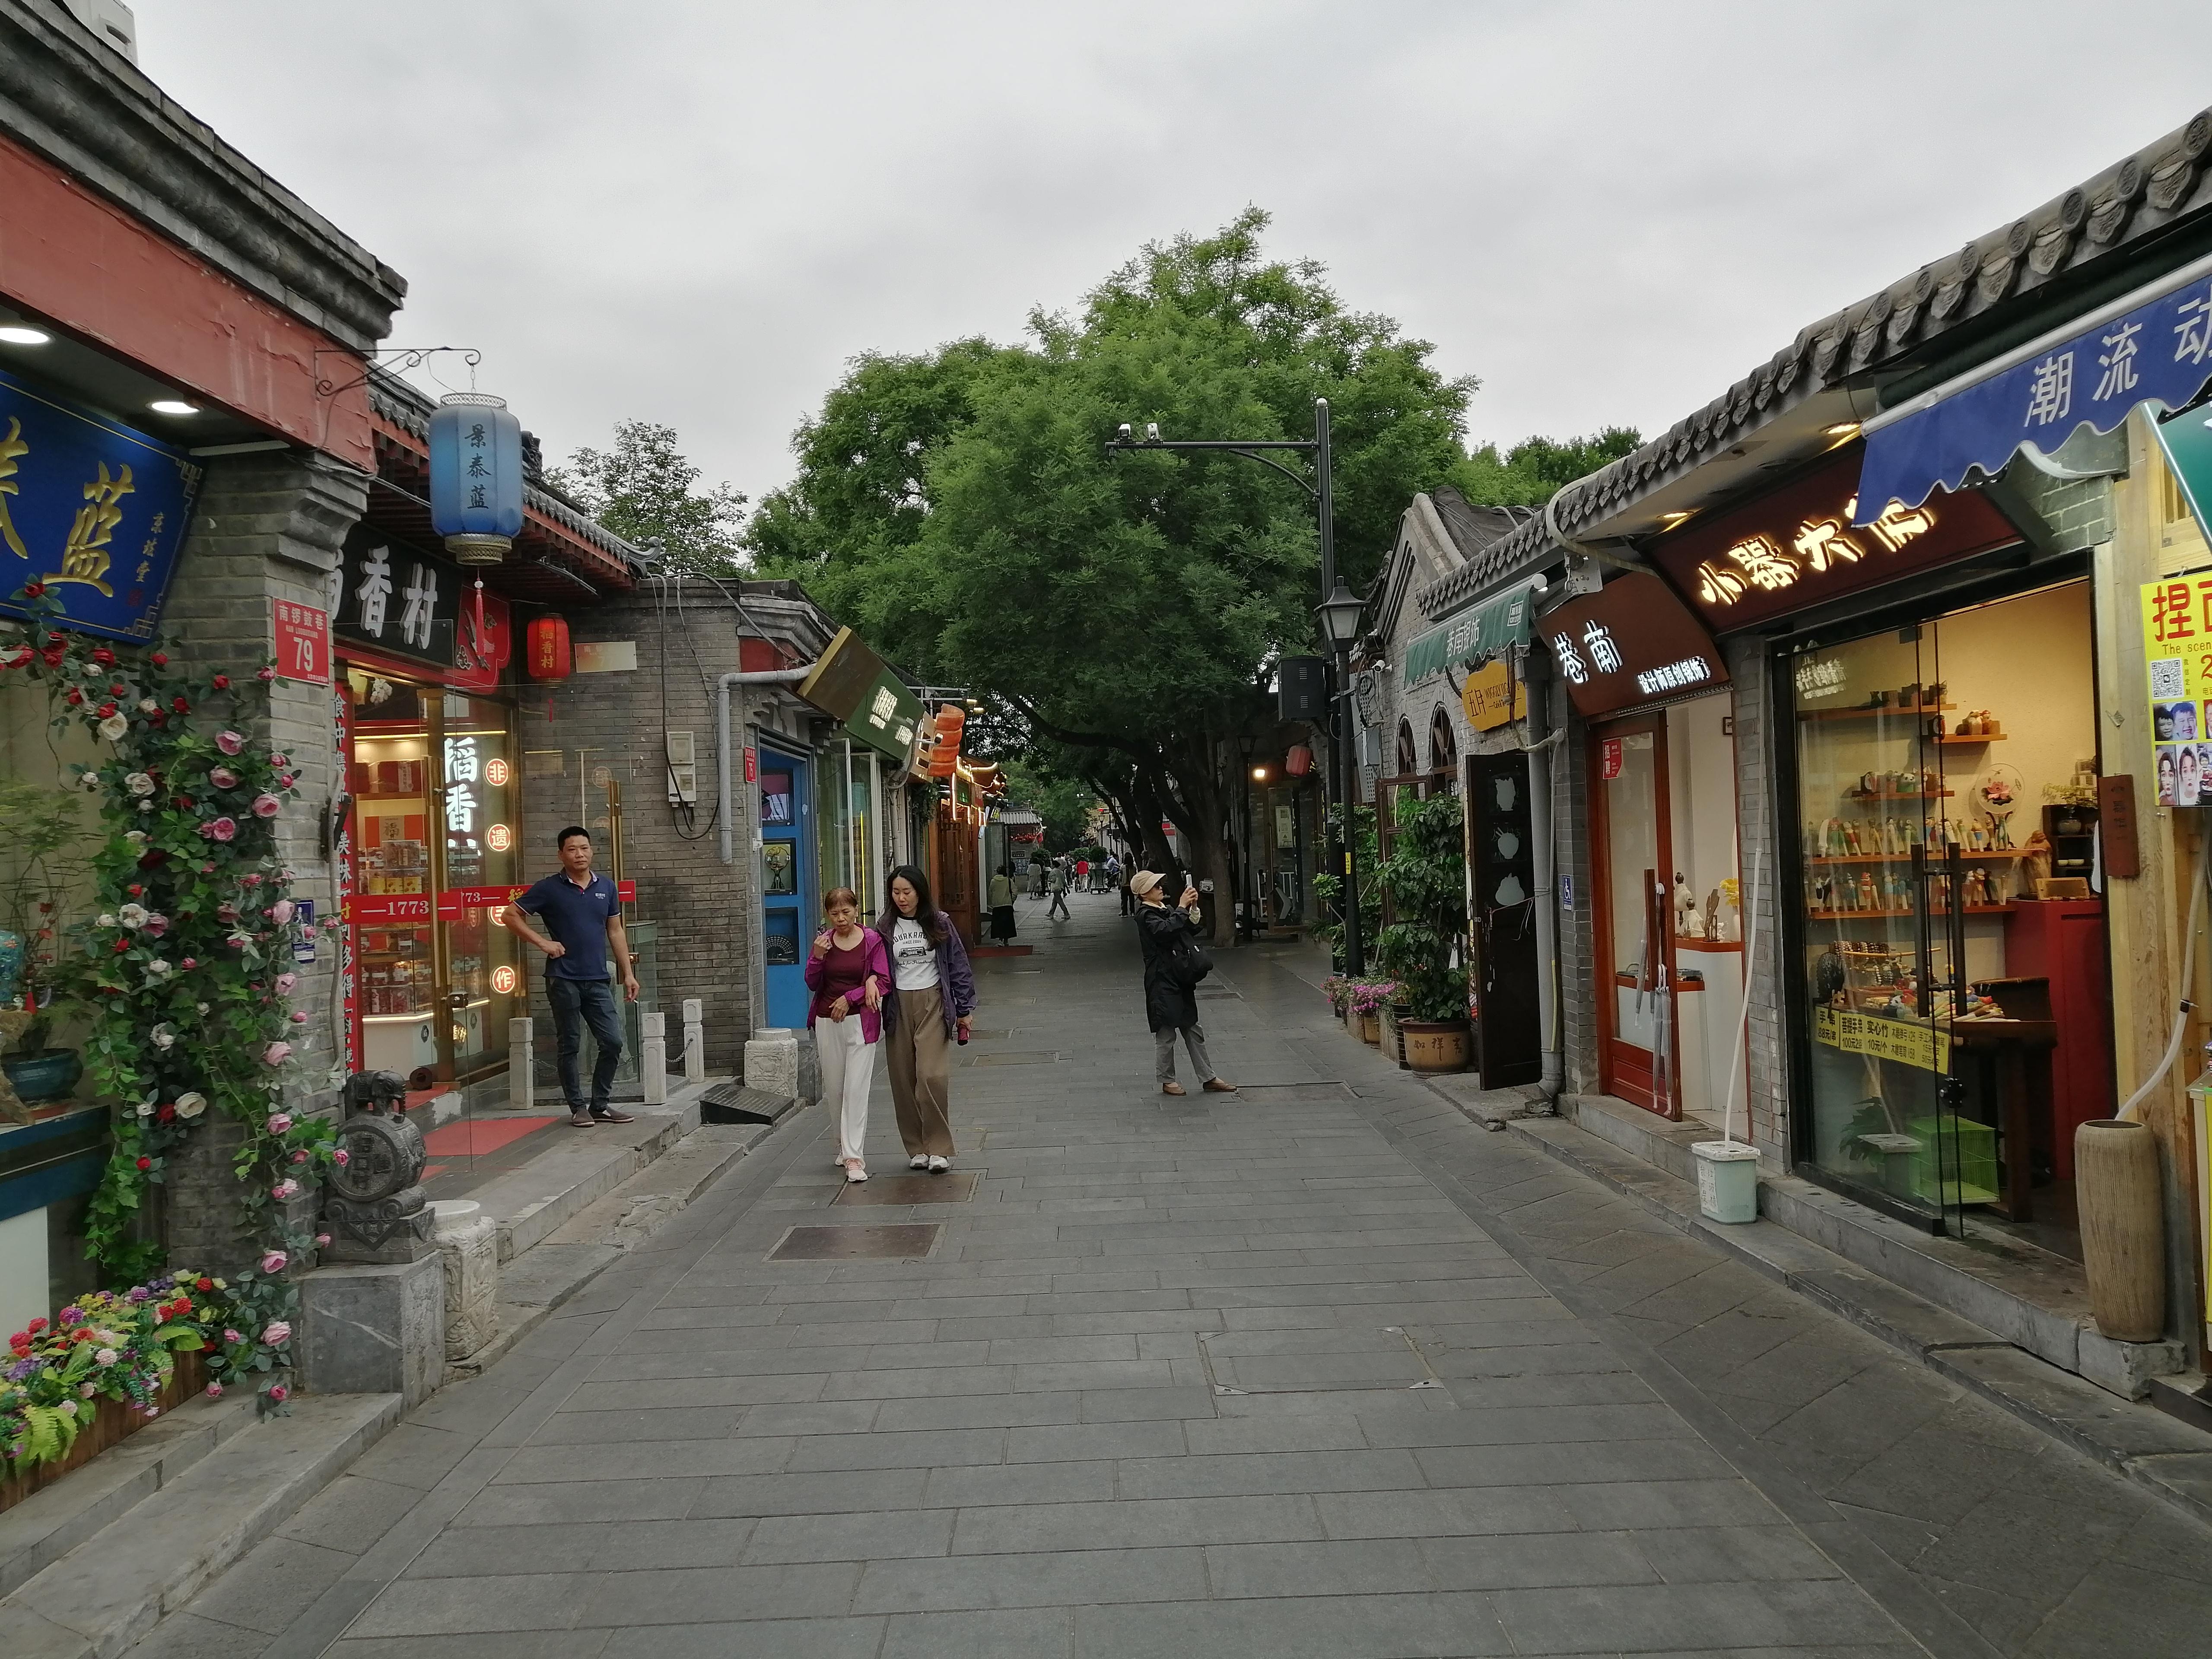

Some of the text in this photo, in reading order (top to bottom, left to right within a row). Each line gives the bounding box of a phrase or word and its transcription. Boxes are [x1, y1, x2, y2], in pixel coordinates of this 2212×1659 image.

[465, 423, 491, 510] 景泰蓝
[279, 604, 324, 630] 南锣鼓巷
[2152, 579, 2212, 642] 捏
[293, 637, 313, 672] 79
[1446, 616, 1480, 658] 巷南银饰
[1554, 620, 1623, 683] 巷南
[2162, 643, 2181, 655] The
[388, 900, 429, 915] 1773
[1867, 1020, 1889, 1038] 实心竹
